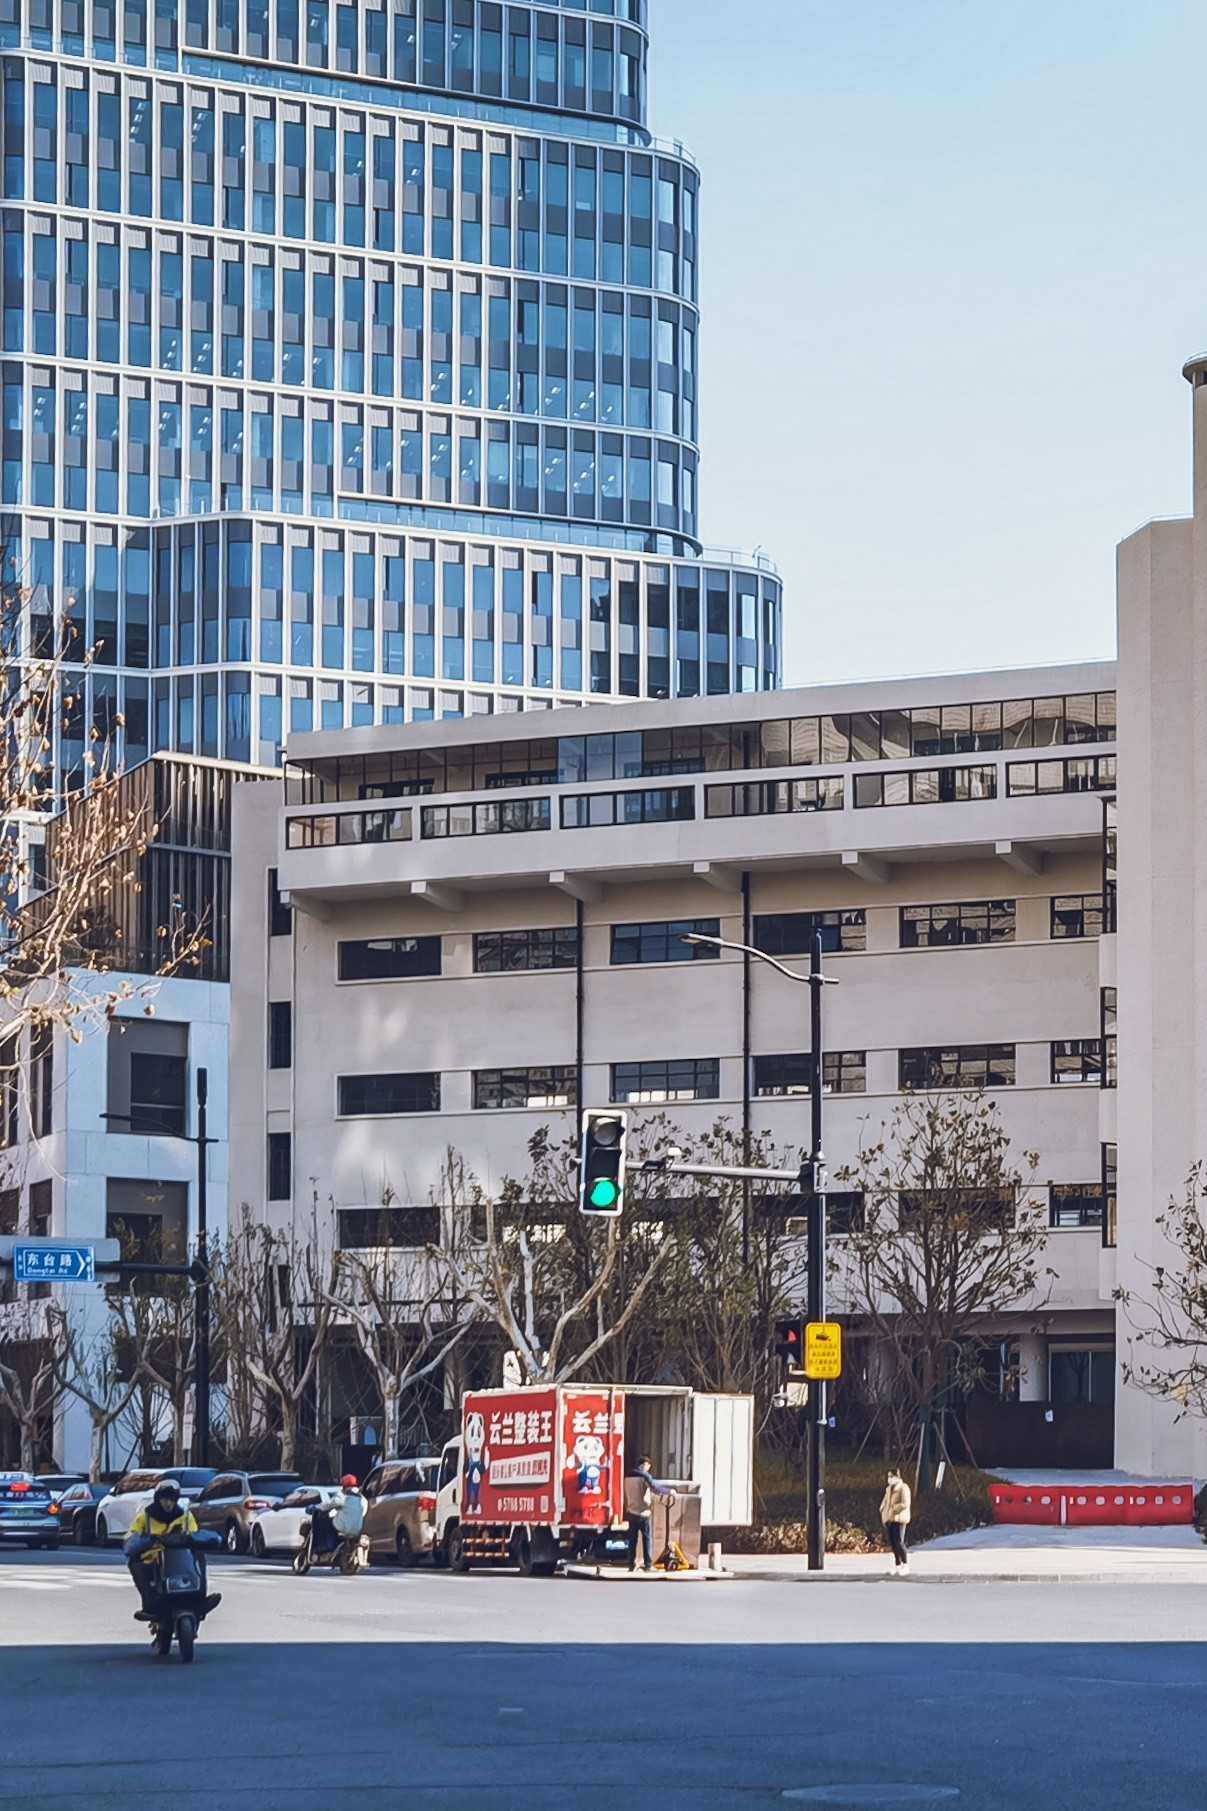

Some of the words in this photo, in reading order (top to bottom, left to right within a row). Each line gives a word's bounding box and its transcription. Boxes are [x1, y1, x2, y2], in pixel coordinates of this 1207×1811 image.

[27, 1252, 72, 1267] 东台路
[489, 1409, 553, 1445] 云兰整装王
